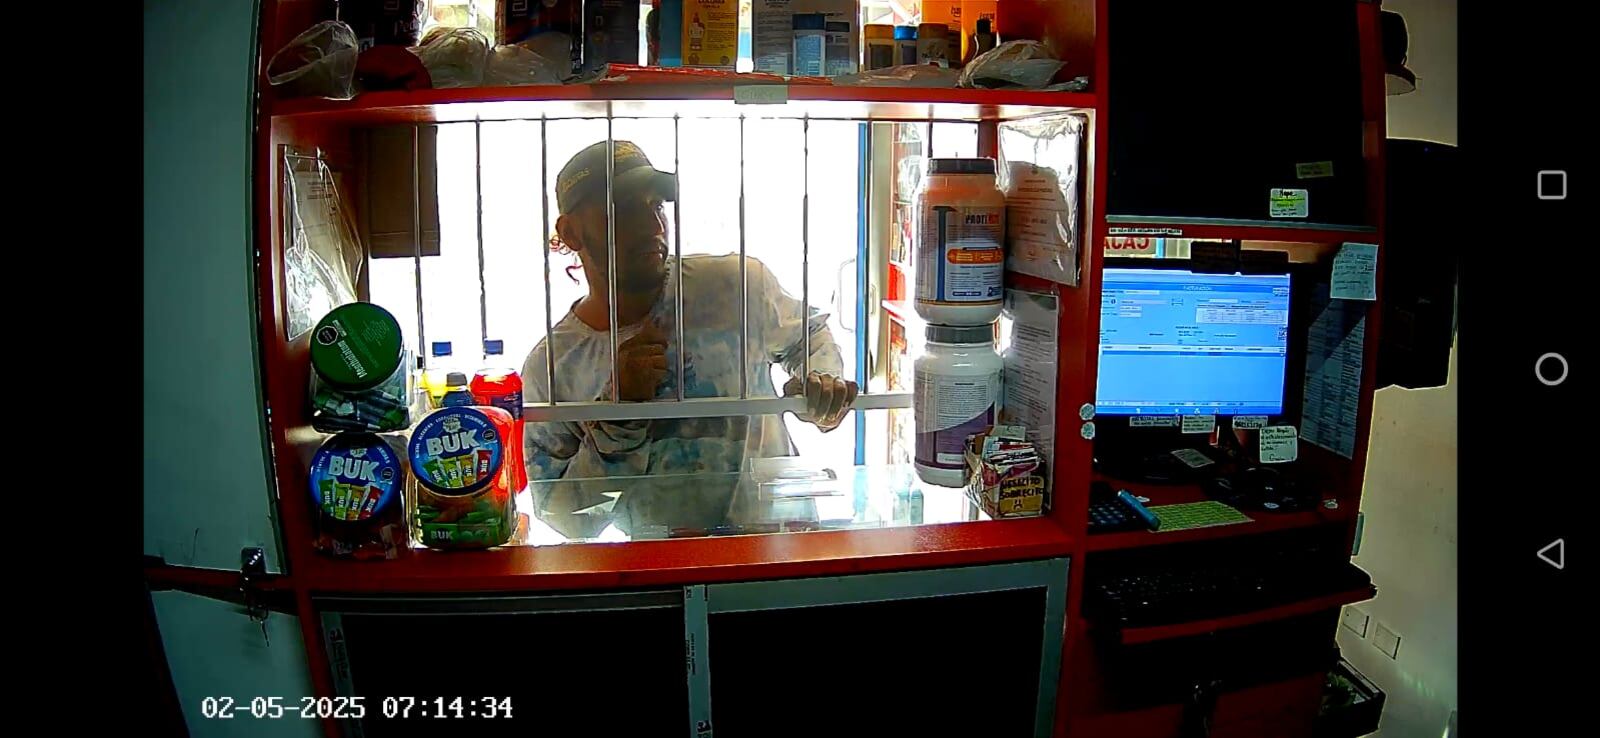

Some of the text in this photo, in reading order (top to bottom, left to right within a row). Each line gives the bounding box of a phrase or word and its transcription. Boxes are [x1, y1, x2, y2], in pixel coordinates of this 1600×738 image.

[425, 428, 481, 457] BUK
[328, 455, 381, 482] BUK
[430, 530, 454, 540] BUK
